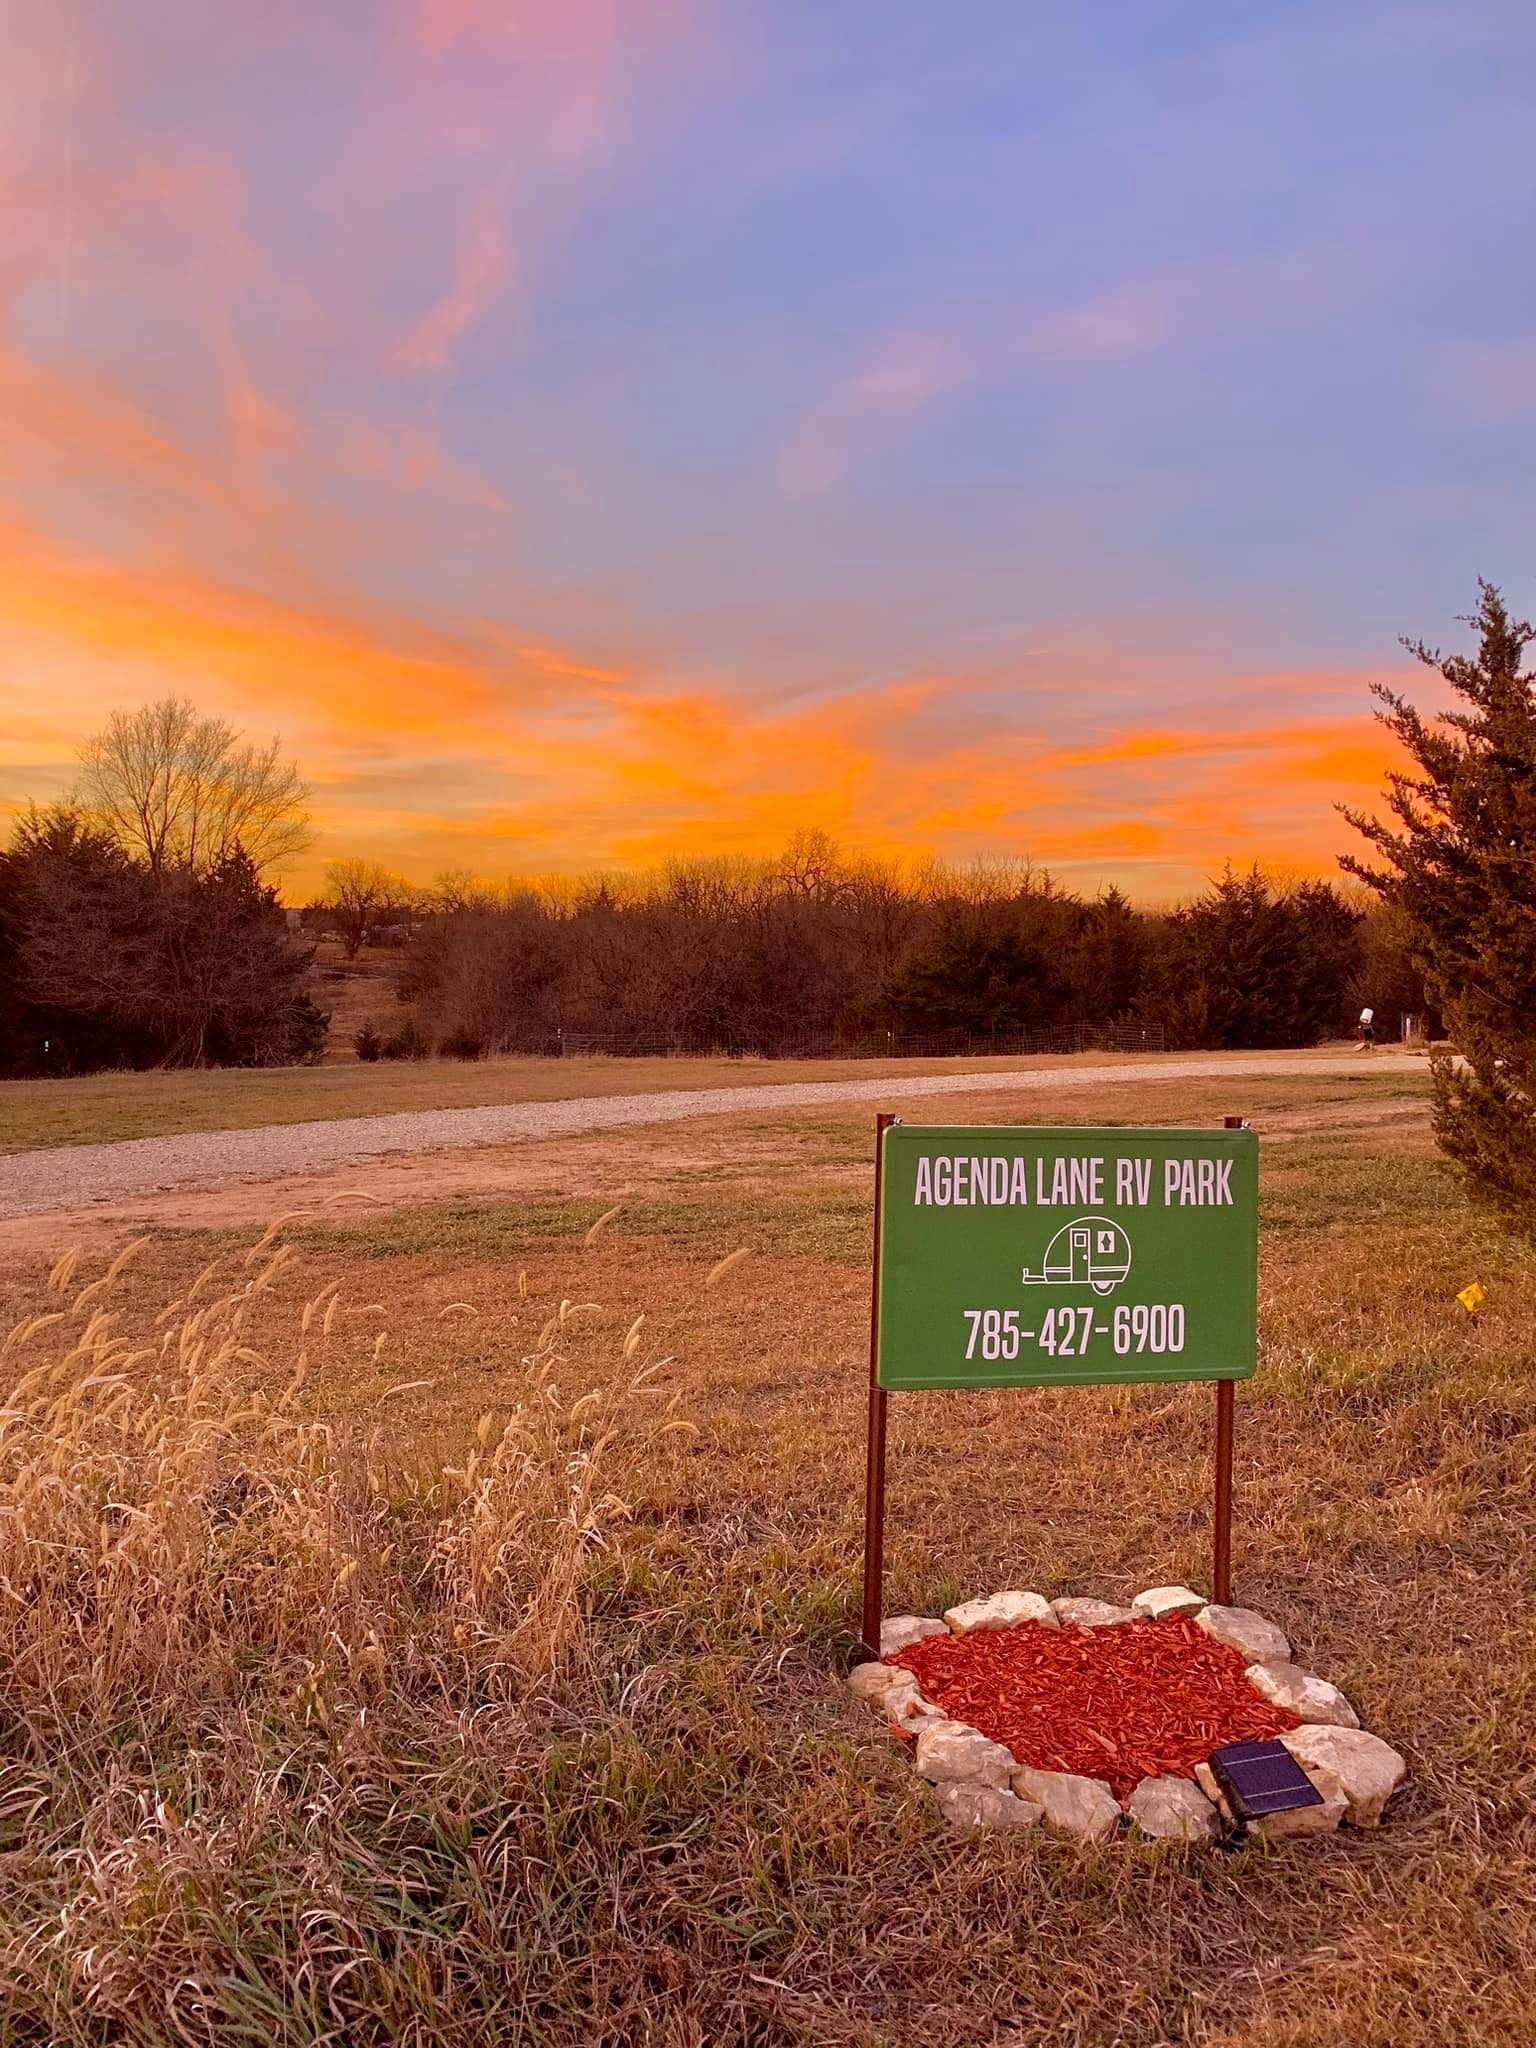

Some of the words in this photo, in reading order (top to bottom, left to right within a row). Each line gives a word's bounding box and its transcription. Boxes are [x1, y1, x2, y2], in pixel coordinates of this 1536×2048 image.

[914, 1156, 1028, 1206] AGENDA
[1036, 1157, 1104, 1205] LANE
[1116, 1158, 1152, 1206] RV
[1164, 1159, 1234, 1206] PARK
[963, 1304, 1185, 1360] 785-427-6900
